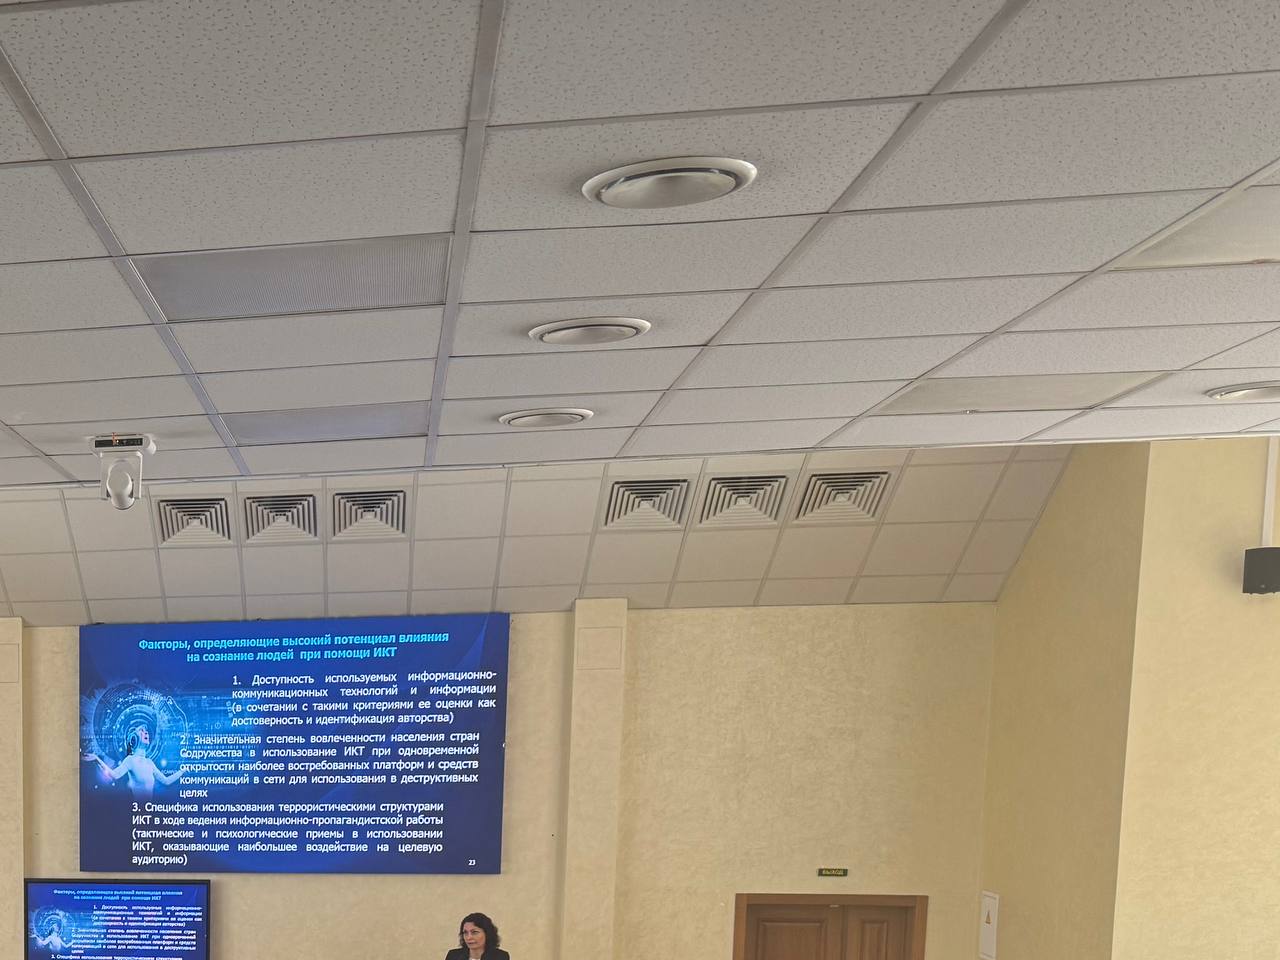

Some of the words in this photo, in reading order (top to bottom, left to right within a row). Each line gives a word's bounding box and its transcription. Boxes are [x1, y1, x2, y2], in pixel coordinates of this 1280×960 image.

[139, 639, 191, 651] Факторы,
[193, 638, 280, 650] определяющие
[282, 633, 331, 646] высокий
[334, 635, 396, 645] потенциал
[399, 633, 449, 643] влияния
[187, 651, 200, 662] на
[202, 650, 254, 661] сознание
[256, 648, 294, 661] людей
[300, 651, 321, 661] при
[324, 649, 370, 659] помощи
[373, 647, 397, 657] ИКТ
[233, 675, 241, 685] 1.
[252, 675, 315, 686] Доступность
[325, 673, 397, 684] используемых
[408, 670, 497, 683] информационно-
[232, 688, 328, 700] коммуникационных
[340, 684, 398, 696] технологий
[410, 687, 417, 695] и
[430, 684, 496, 696] информации
[232, 702, 242, 714] (в
[246, 703, 297, 712] сочетании
[302, 703, 308, 711] с
[312, 702, 348, 711] такими
[353, 701, 414, 712] критериями
[418, 700, 431, 709] ее
[435, 700, 473, 710] оценки
[478, 699, 496, 708] как
[231, 717, 304, 727] достоверность
[315, 713, 395, 726] идентификация
[397, 711, 454, 725] авторства)
[194, 734, 261, 745] Значительная
[266, 735, 306, 744] степень
[310, 734, 386, 743] вовлеченности
[391, 733, 445, 742] населения
[450, 732, 480, 743] стран
[180, 747, 242, 759] Содружества
[250, 749, 256, 757] в
[263, 748, 337, 757] использование
[344, 746, 365, 756] ИКТ
[372, 748, 391, 758] при
[398, 744, 479, 757] одновременной
[179, 763, 235, 774] открытости
[238, 760, 285, 771] наиболее
[288, 760, 370, 772] востребованных
[373, 759, 424, 771] платформ
[427, 761, 435, 769] и
[438, 760, 479, 771] средств
[179, 773, 249, 786] коммуникаций
[253, 776, 260, 784] в
[263, 776, 285, 784] сети
[288, 776, 307, 785] для
[311, 775, 386, 784] использования
[390, 775, 397, 783] в
[400, 774, 479, 785] деструктивных
[179, 790, 208, 799] целях
[132, 802, 141, 812] 3.
[145, 802, 198, 814] Специфика
[202, 804, 274, 812] использования
[278, 803, 376, 814] террористическими
[380, 803, 444, 813] структурами
[132, 815, 152, 825] ИКТ
[154, 817, 160, 825] в
[162, 817, 185, 826] ходе
[187, 817, 227, 826] ведения
[230, 814, 403, 827] информационно-пропагандистской
[406, 814, 443, 827] работы
[132, 828, 194, 840] (тактические
[201, 830, 208, 838] и
[216, 830, 298, 838] психологические
[306, 830, 344, 840] приемы
[352, 830, 359, 838] в
[366, 830, 443, 839] использовании
[132, 841, 154, 853] ИКТ,
[162, 843, 229, 852] оказывающие
[238, 841, 297, 851] наибольшее
[306, 839, 368, 853] воздействие
[377, 844, 389, 852] на
[398, 844, 443, 854] целевую
[132, 854, 188, 866] аудиторию)
